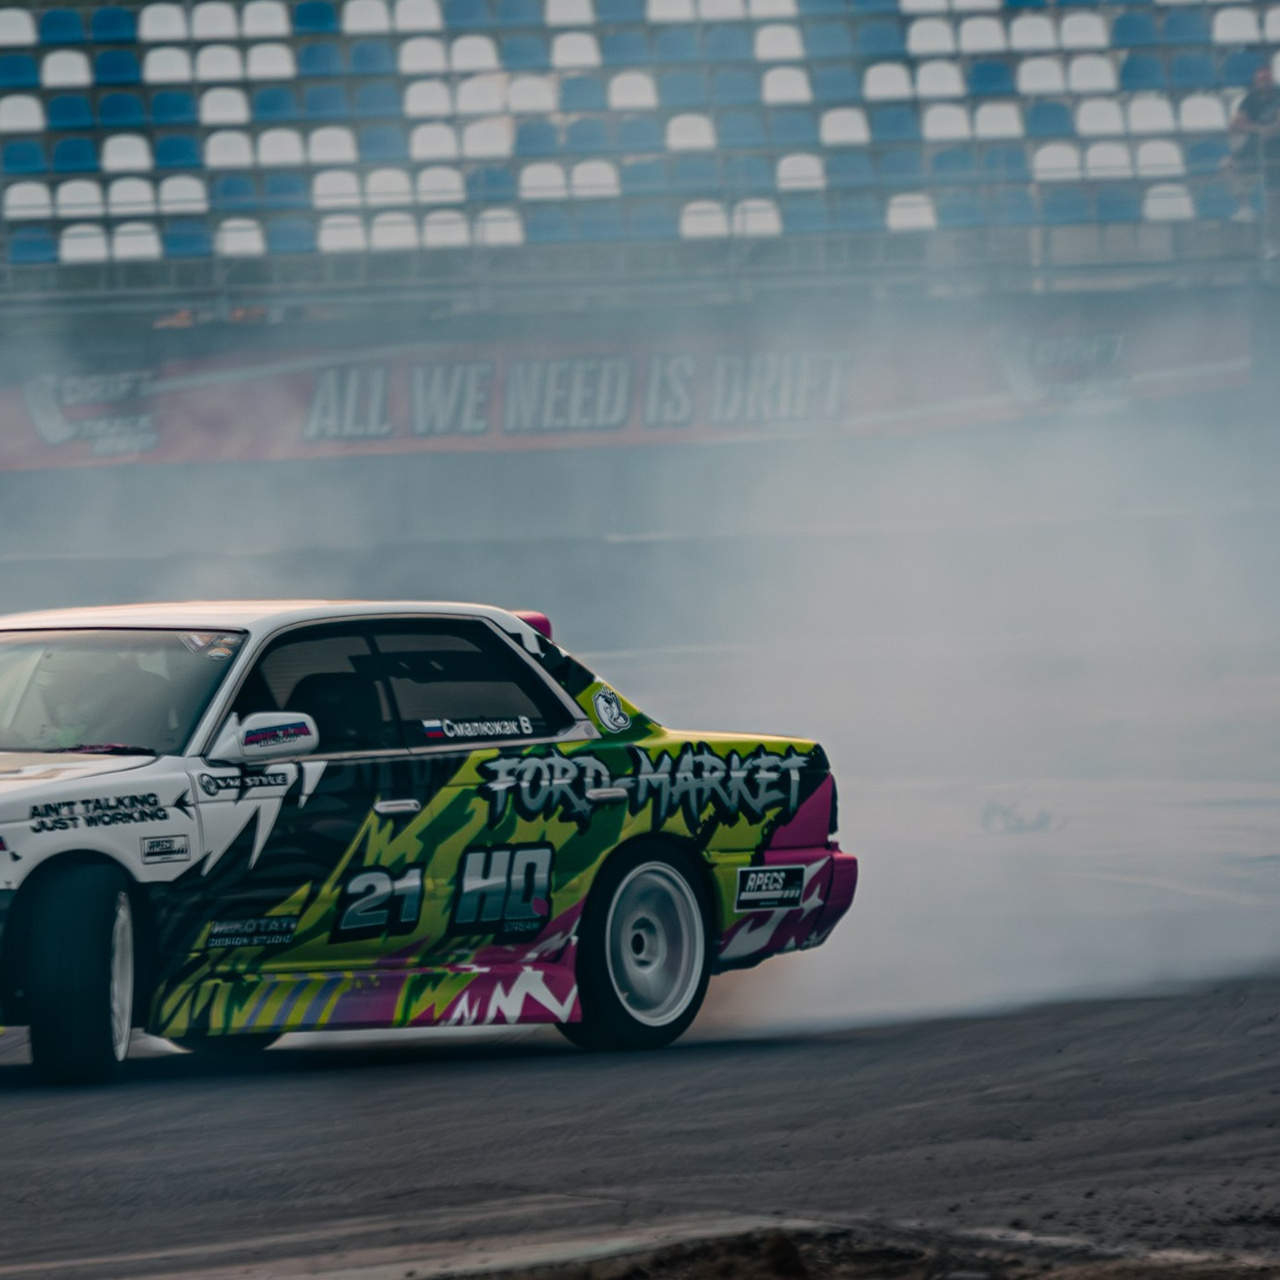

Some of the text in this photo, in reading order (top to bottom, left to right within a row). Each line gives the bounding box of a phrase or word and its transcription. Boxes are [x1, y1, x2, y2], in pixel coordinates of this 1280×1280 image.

[302, 349, 852, 440] ALL WE NEED IS DRIFT
[80, 792, 160, 813] TALKING
[30, 807, 169, 833] JUST WORKING
[745, 871, 786, 892] APECS
[340, 867, 422, 930] 21
